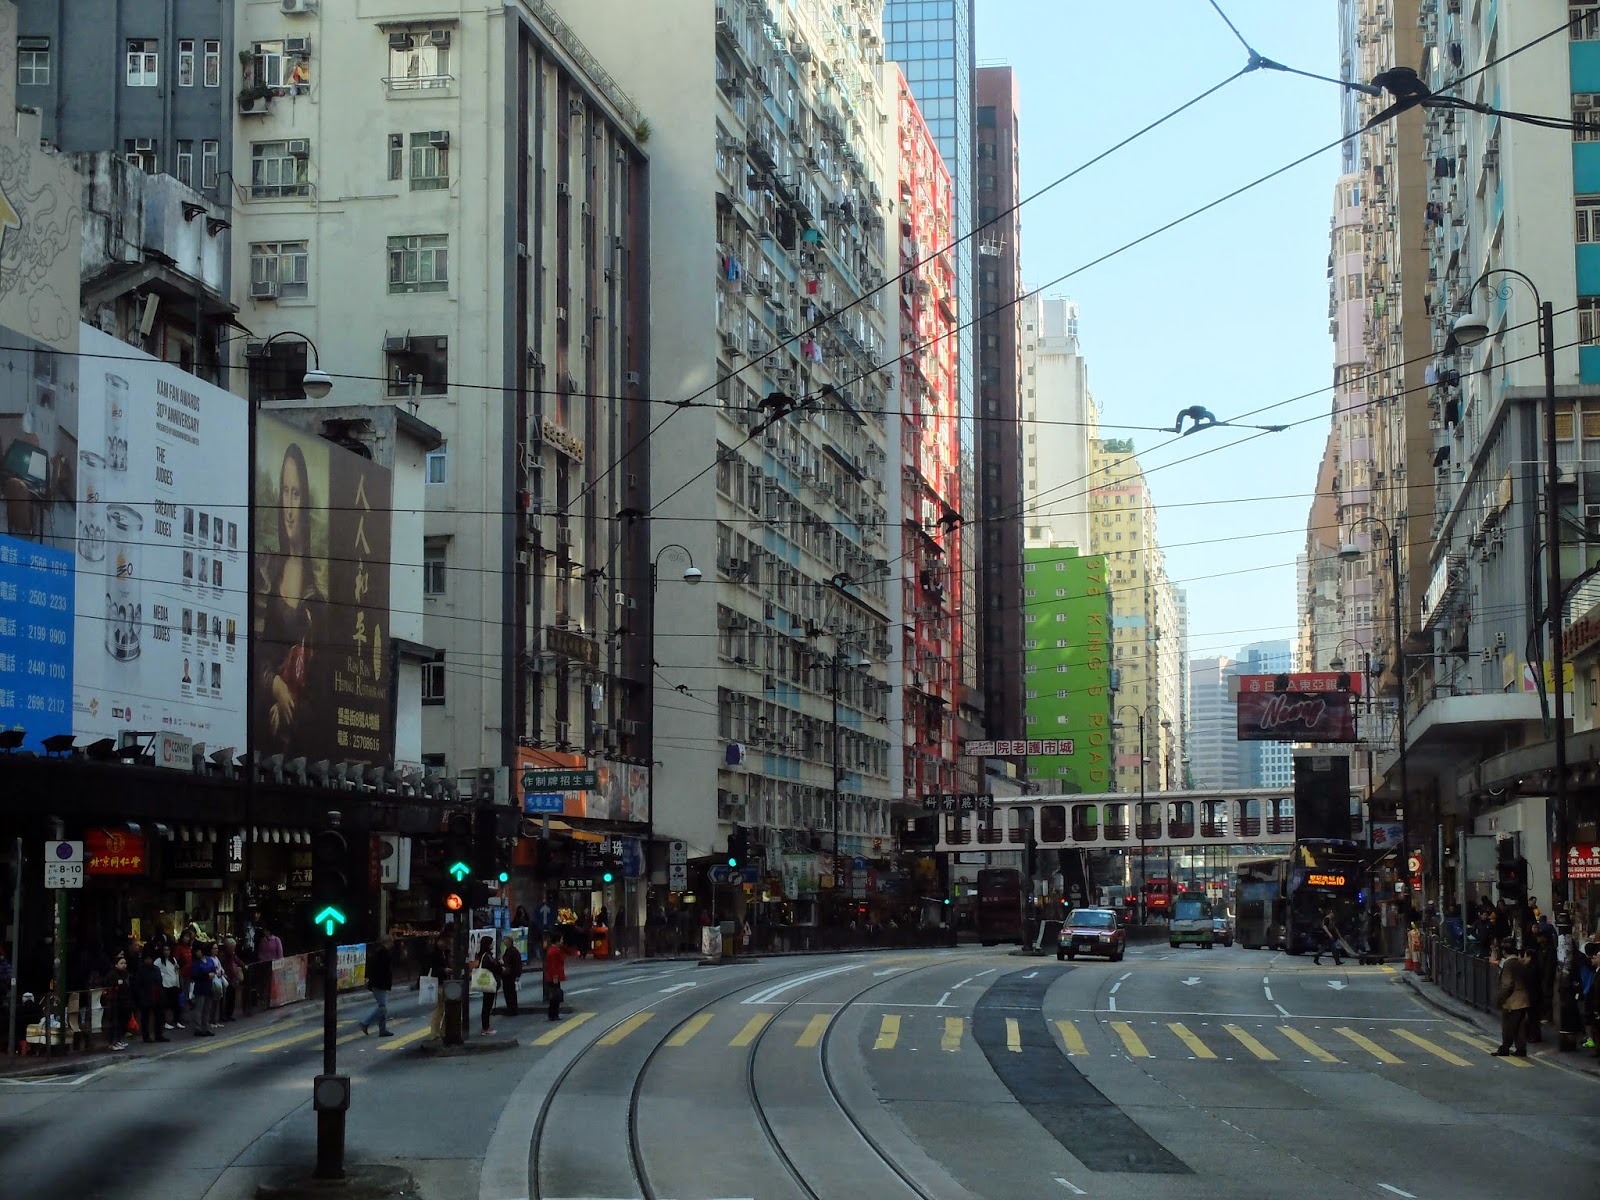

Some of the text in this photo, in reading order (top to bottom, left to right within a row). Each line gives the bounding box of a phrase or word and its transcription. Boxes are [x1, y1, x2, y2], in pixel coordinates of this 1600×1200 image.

[157, 379, 200, 412] KAM FAN AWARDS
[168, 407, 199, 433] ANNIVERSARY
[156, 446, 165, 464] THE
[156, 466, 173, 486] JUDGES
[155, 499, 177, 520] CREATIVE
[155, 519, 171, 537] JUDGES
[49, 593, 67, 611] 2233
[153, 604, 168, 621] MEDIA
[28, 625, 46, 641] 2199
[48, 629, 66, 645] 9900
[153, 624, 170, 642] JUDGES
[1088, 613, 1102, 697] KING'S
[28, 660, 46, 676] 2440
[49, 664, 66, 680] 1010
[1300, 679, 1347, 692] 東亞銀
[48, 699, 65, 714] 2112
[1089, 714, 1104, 783] ROAD
[59, 865, 82, 873] 8-10
[90, 855, 142, 869] 北京同仁堂
[1336, 876, 1345, 885] 10
